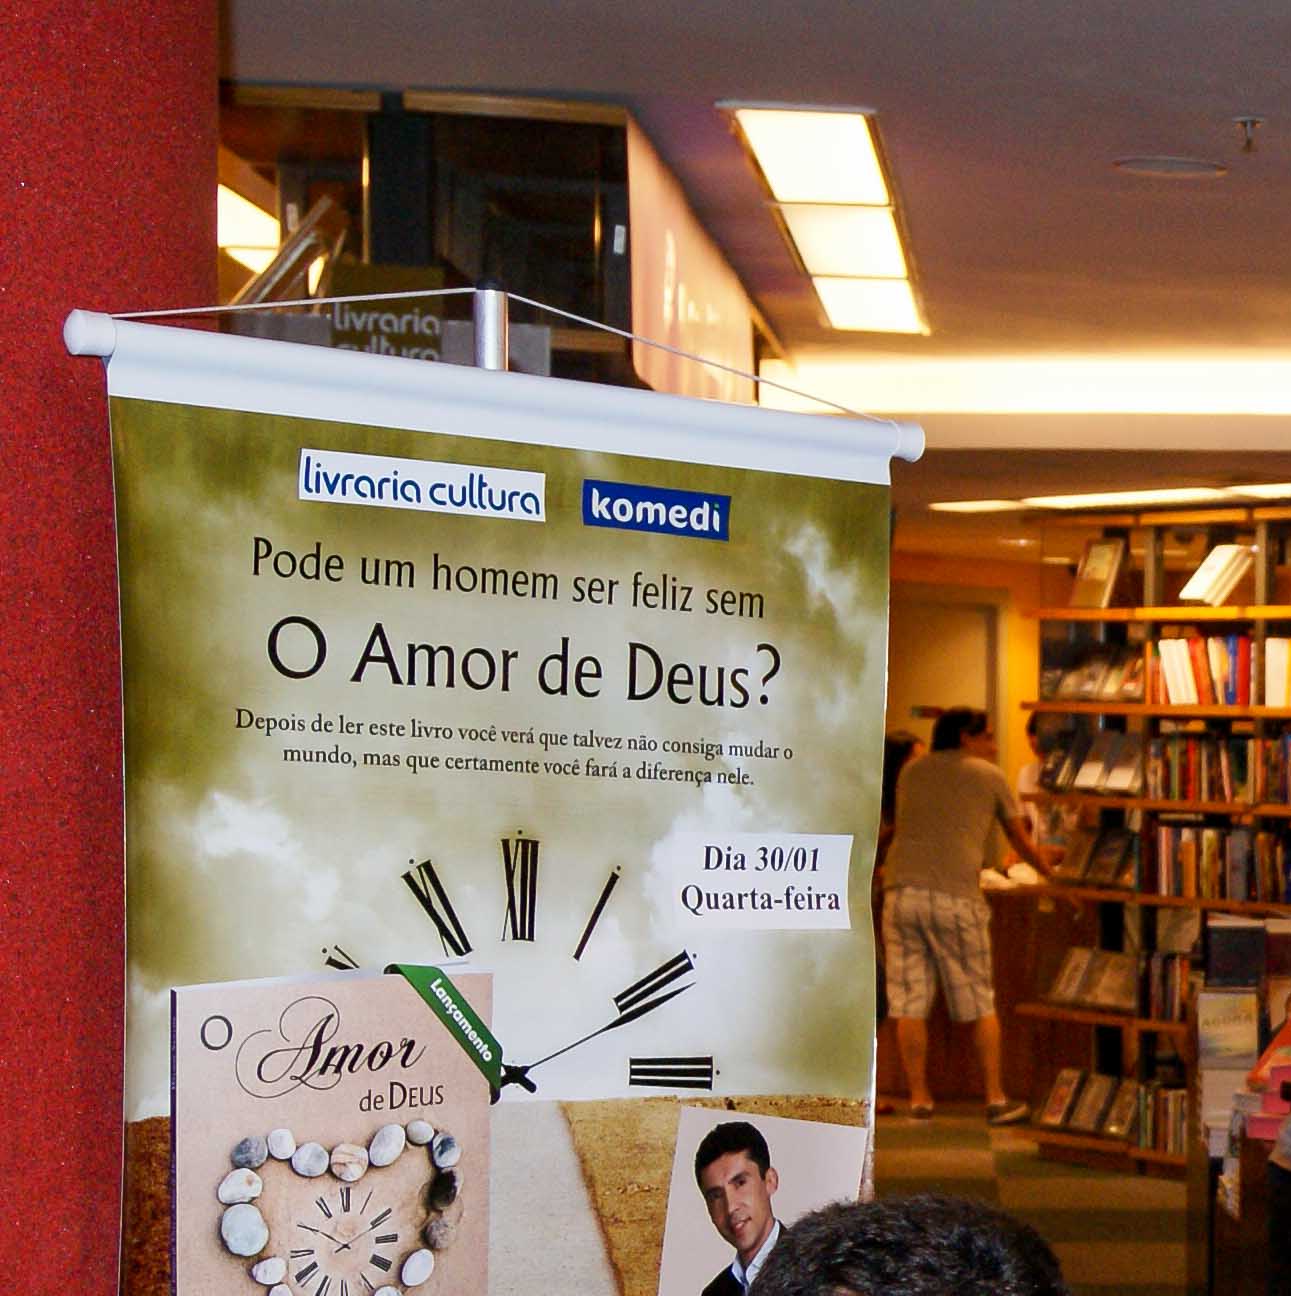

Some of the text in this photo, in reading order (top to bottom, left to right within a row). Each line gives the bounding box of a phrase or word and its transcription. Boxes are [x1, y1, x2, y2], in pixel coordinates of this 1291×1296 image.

[334, 302, 440, 335] livraria
[304, 456, 541, 515] livraria cultura
[591, 487, 721, 532] komedi
[252, 536, 765, 618] Pode um homem ser feliz sem
[267, 615, 781, 709] O Amor de Deus?
[235, 708, 793, 761] Depois de ler este livro você verá que talvez não consiga mudar o
[283, 744, 755, 787] mundo, mas que certamente você fará a diferença nele.
[703, 845, 821, 873] Dia 30/01
[681, 884, 841, 916] Quarta-feira
[430, 977, 493, 1062] Lançamento
[200, 1015, 233, 1051] O
[235, 996, 427, 1099] Amor
[359, 1089, 385, 1112] de
